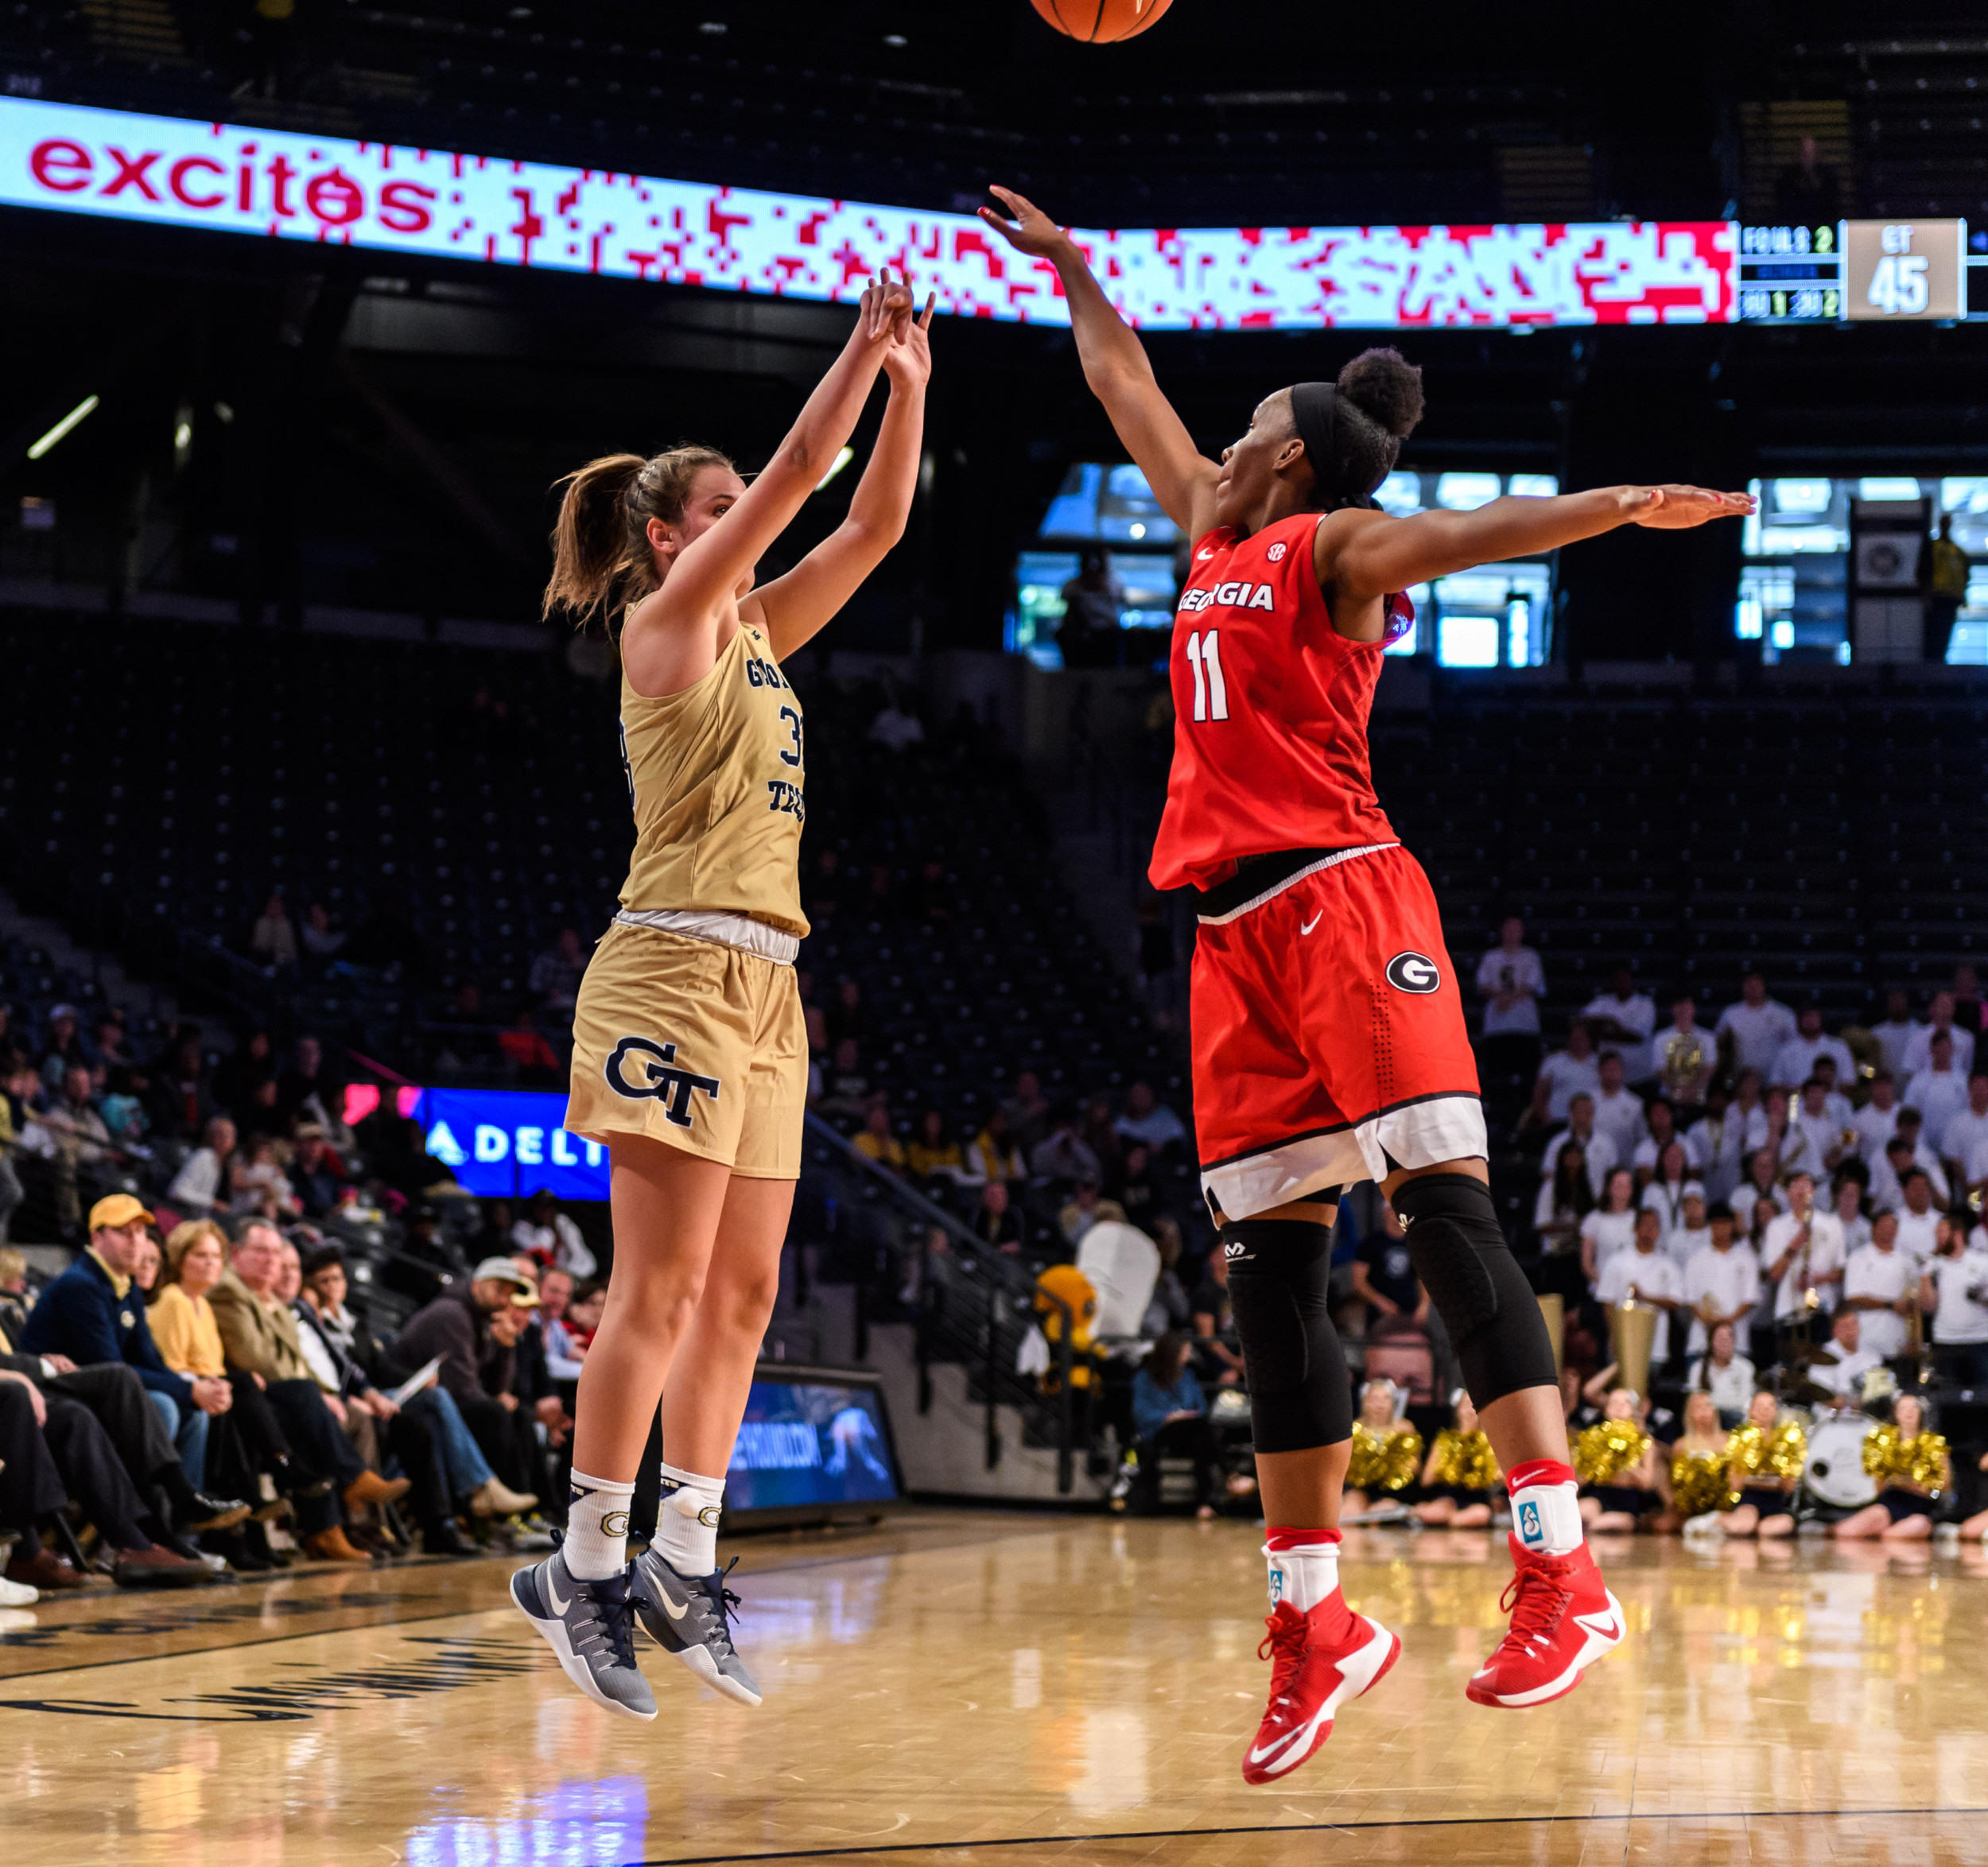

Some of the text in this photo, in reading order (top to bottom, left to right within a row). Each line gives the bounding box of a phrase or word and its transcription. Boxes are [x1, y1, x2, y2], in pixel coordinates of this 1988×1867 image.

[29, 138, 436, 234] excites
[1867, 255, 1929, 315] 45
[1268, 542, 1287, 562] SEC
[1178, 580, 1275, 612] GEORGIA
[1186, 628, 1230, 724] 11
[779, 703, 805, 773] 3
[1386, 950, 1440, 994] G
[604, 1034, 720, 1130] GT
[474, 1123, 603, 1168] DELT
